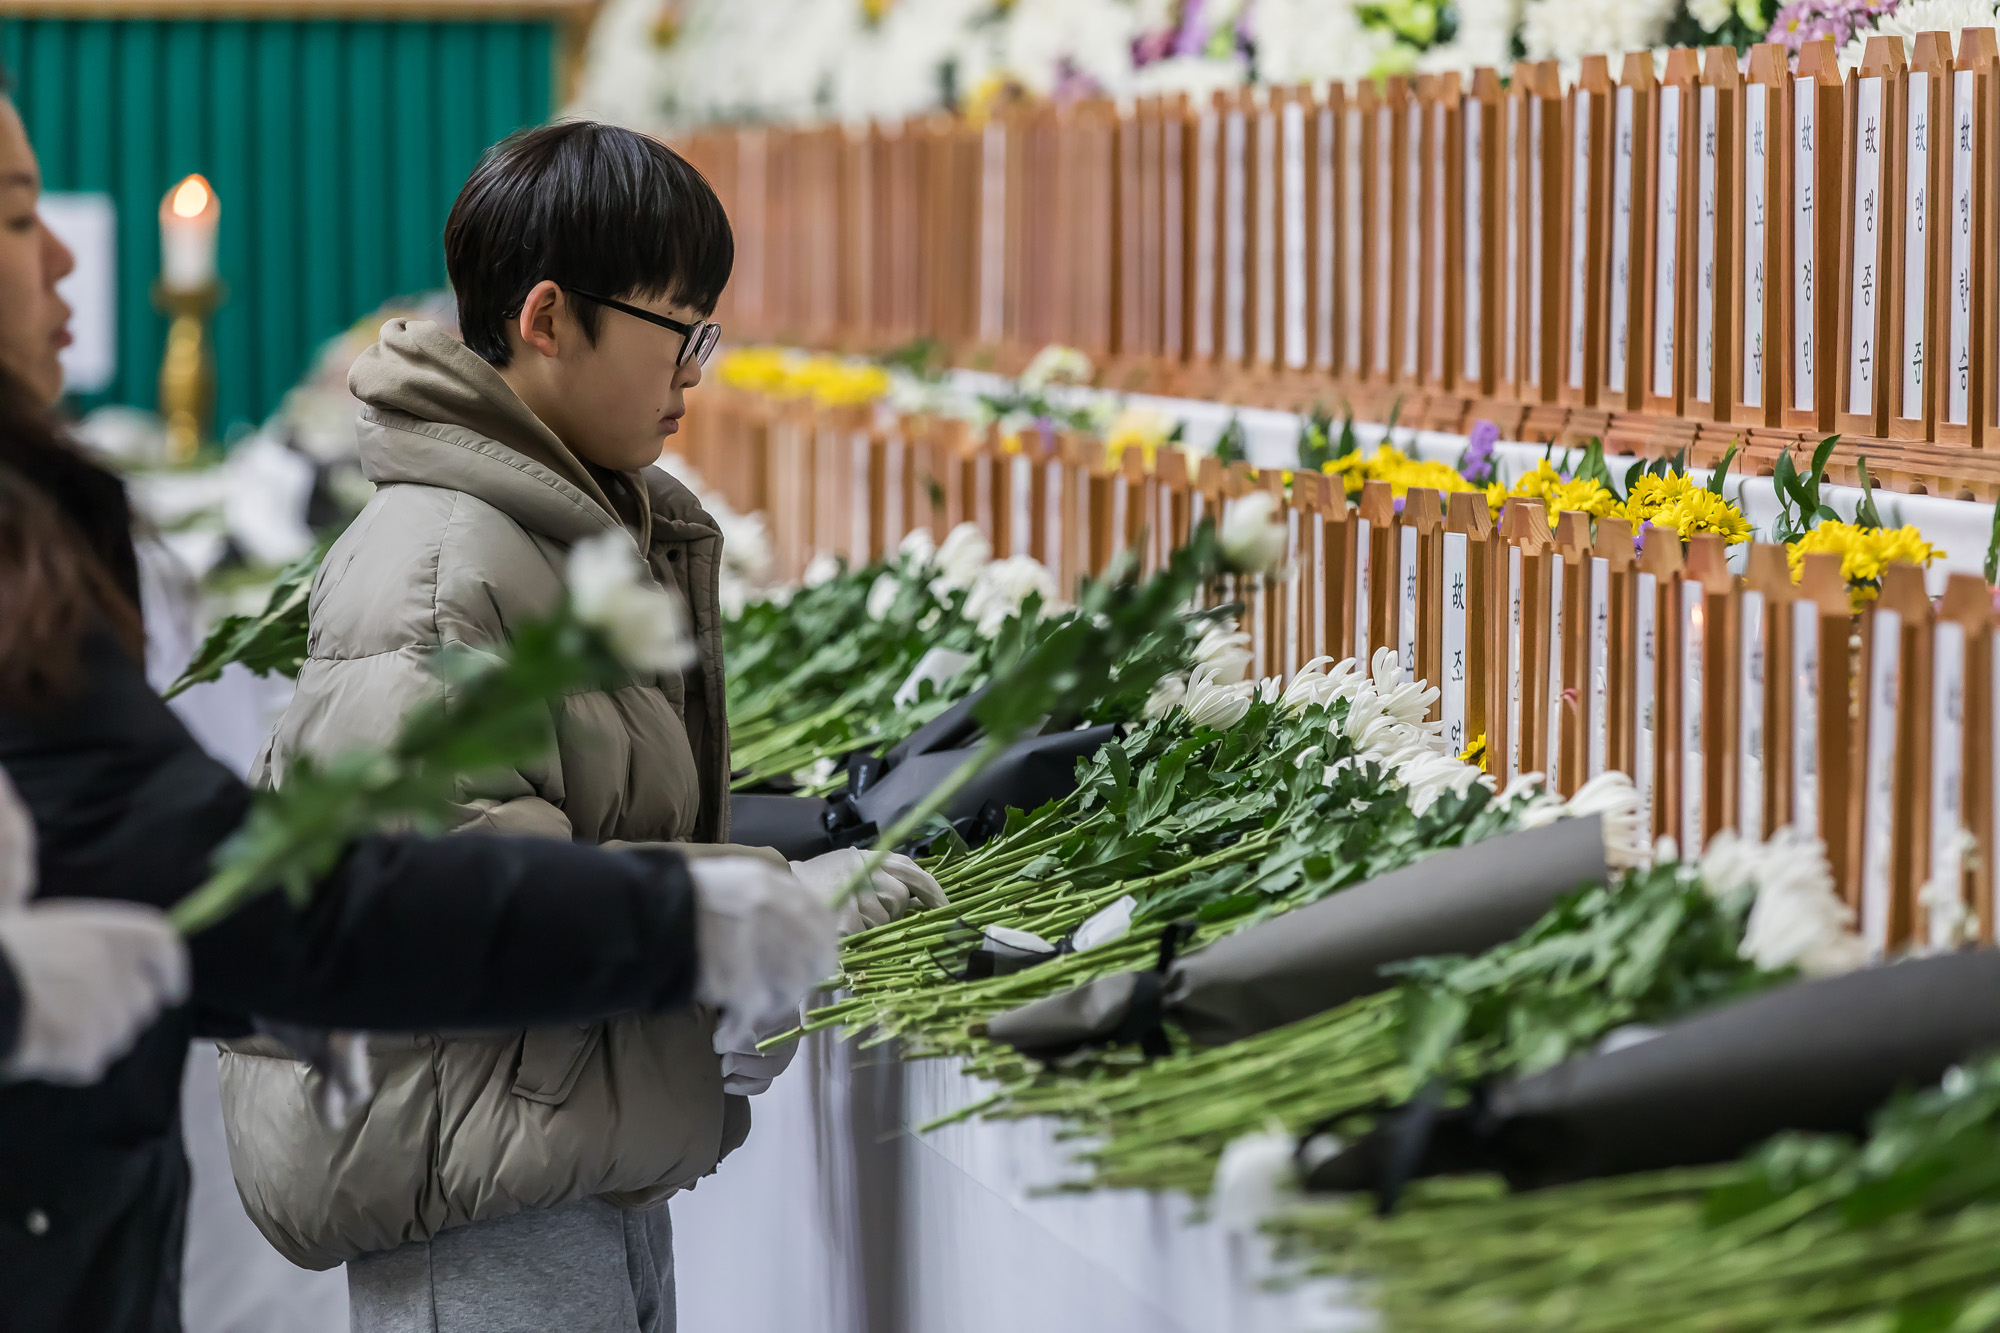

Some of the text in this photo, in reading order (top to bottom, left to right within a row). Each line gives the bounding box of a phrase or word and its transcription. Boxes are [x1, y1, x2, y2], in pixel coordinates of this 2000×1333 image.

[1801, 115, 1813, 151] 故
[1915, 113, 1926, 151] 故
[1960, 113, 1971, 152] 故
[1859, 116, 1877, 381] 故 맹종근
[1452, 572, 1464, 609] 故
